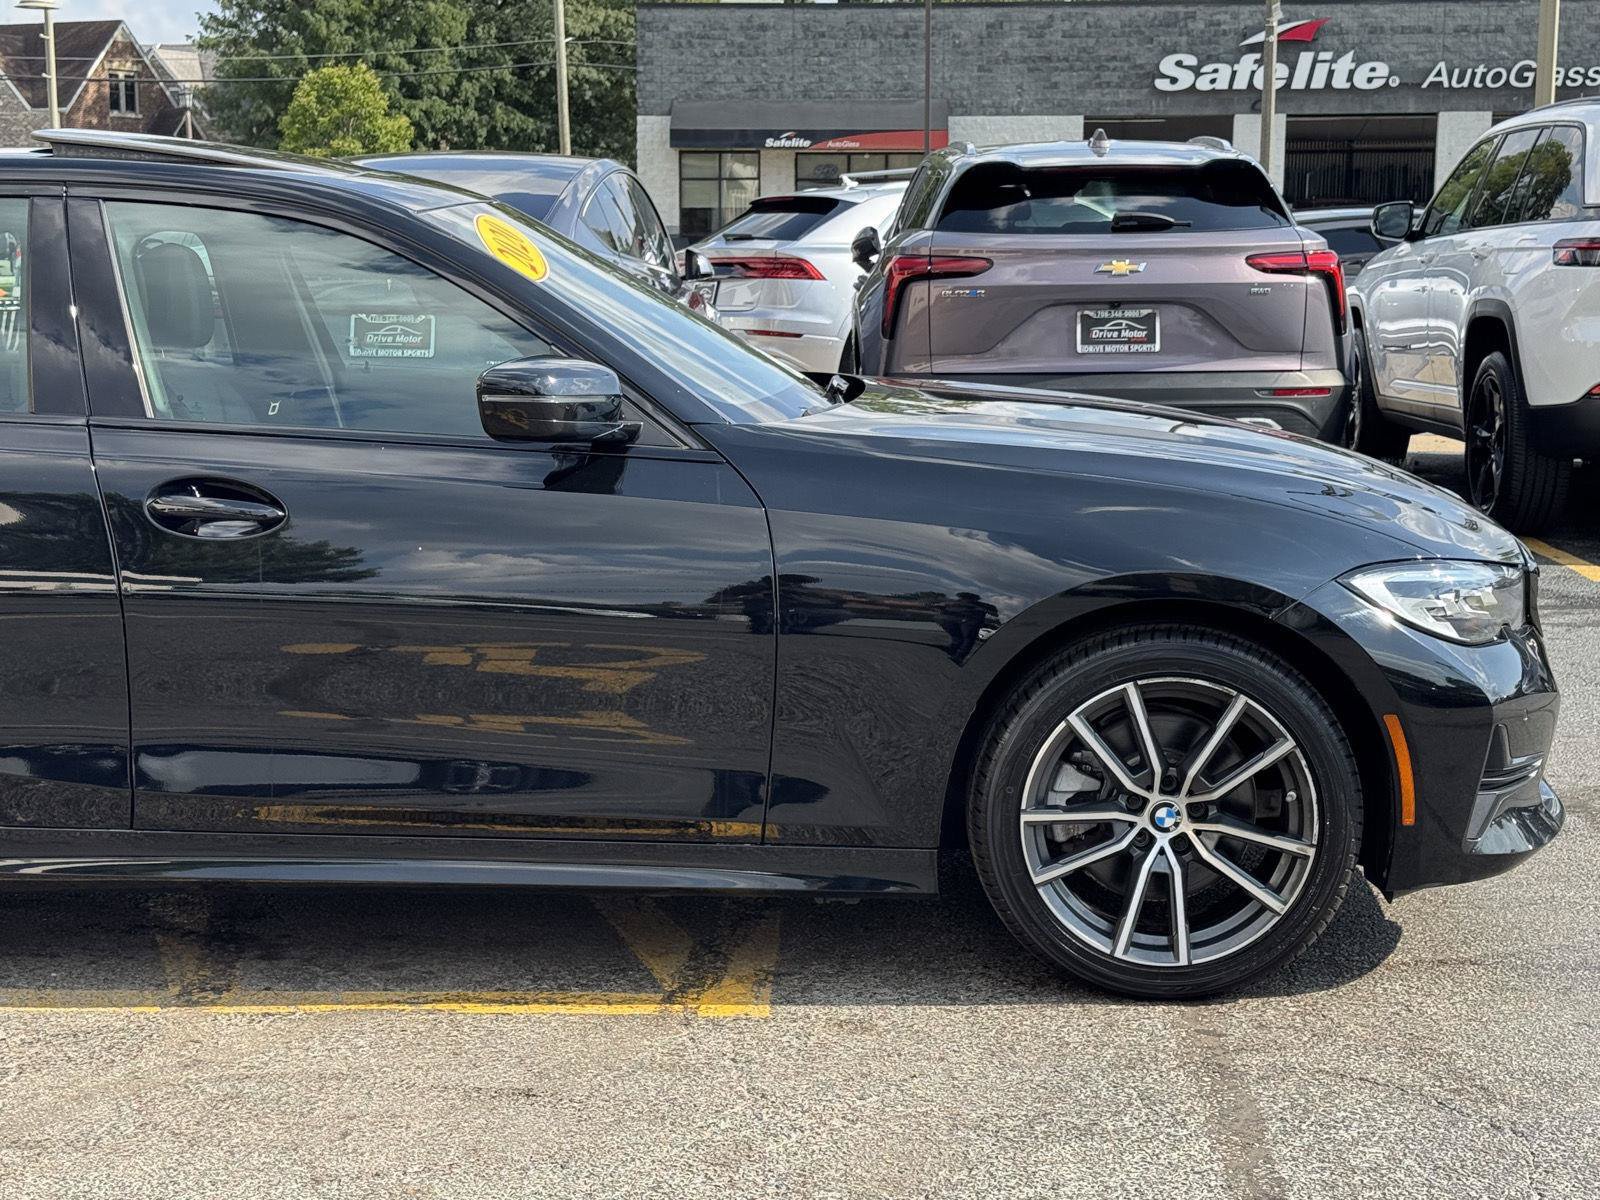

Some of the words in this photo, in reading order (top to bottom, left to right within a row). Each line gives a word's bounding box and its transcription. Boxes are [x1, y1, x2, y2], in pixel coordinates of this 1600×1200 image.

[1421, 59, 1600, 89] AutoGass
[765, 137, 812, 148] Safelite
[395, 334, 423, 342] Motor
[1121, 329, 1148, 338] Motor
[378, 348, 402, 357] MOTOR
[403, 348, 429, 357] SPORTS
[1105, 344, 1129, 353] MOTOR
[1130, 343, 1155, 352] SPORTS
